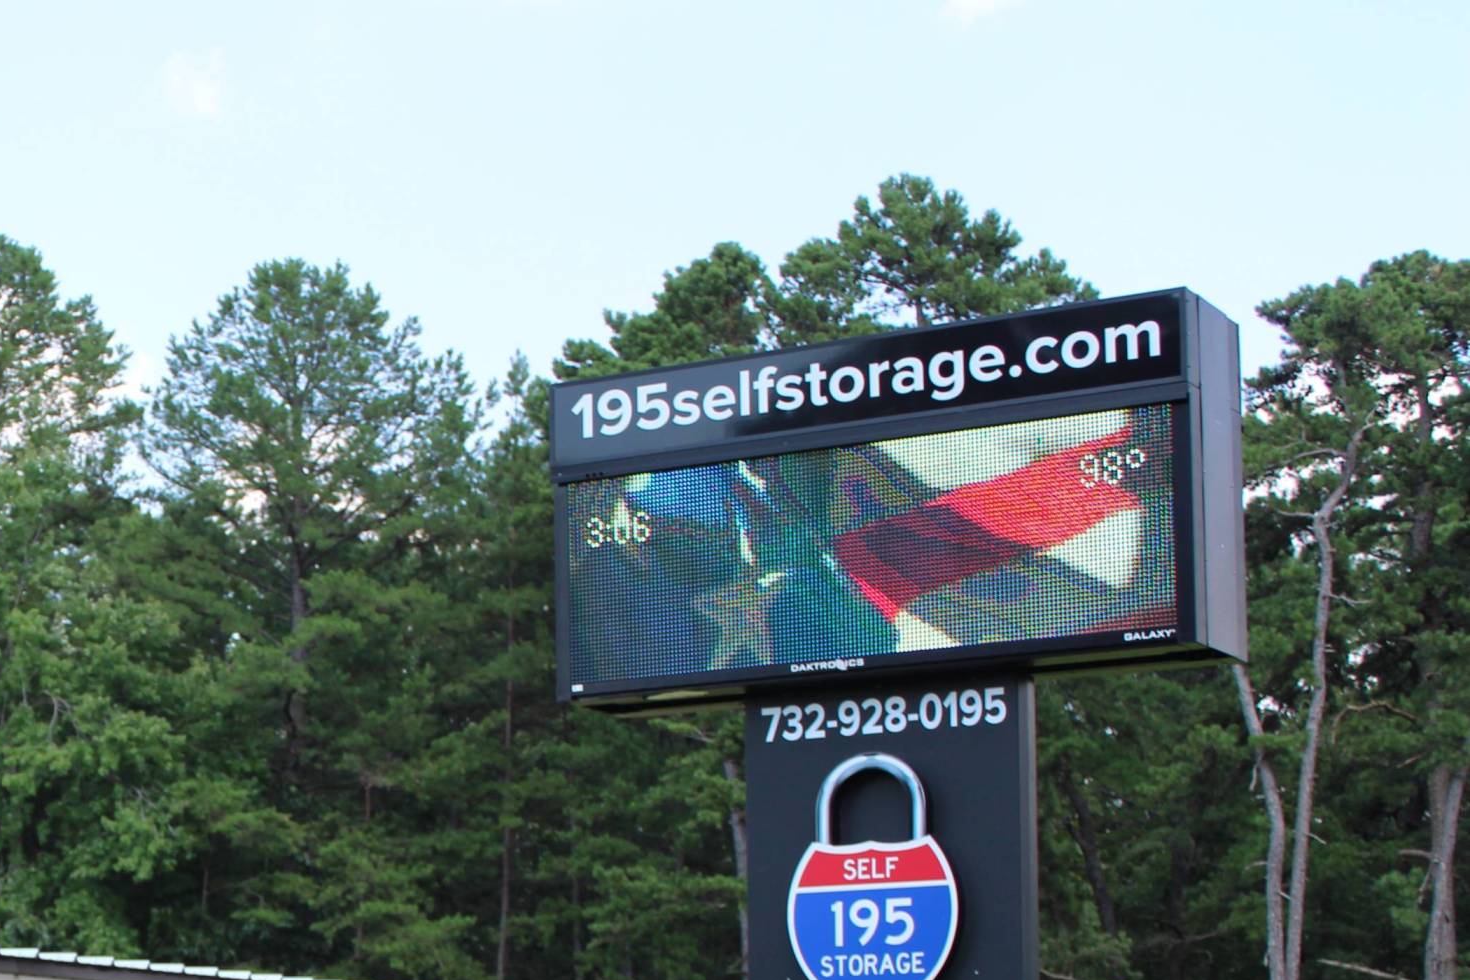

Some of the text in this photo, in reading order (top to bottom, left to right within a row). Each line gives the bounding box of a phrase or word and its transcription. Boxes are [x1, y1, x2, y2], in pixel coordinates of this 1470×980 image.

[571, 319, 1162, 439] 195selfstorage.com
[790, 657, 865, 673] DAKTROICS
[761, 687, 1007, 743] 732-928-0195
[843, 856, 899, 881] SELF
[830, 897, 915, 948] 195
[820, 952, 925, 977] STORAGE
